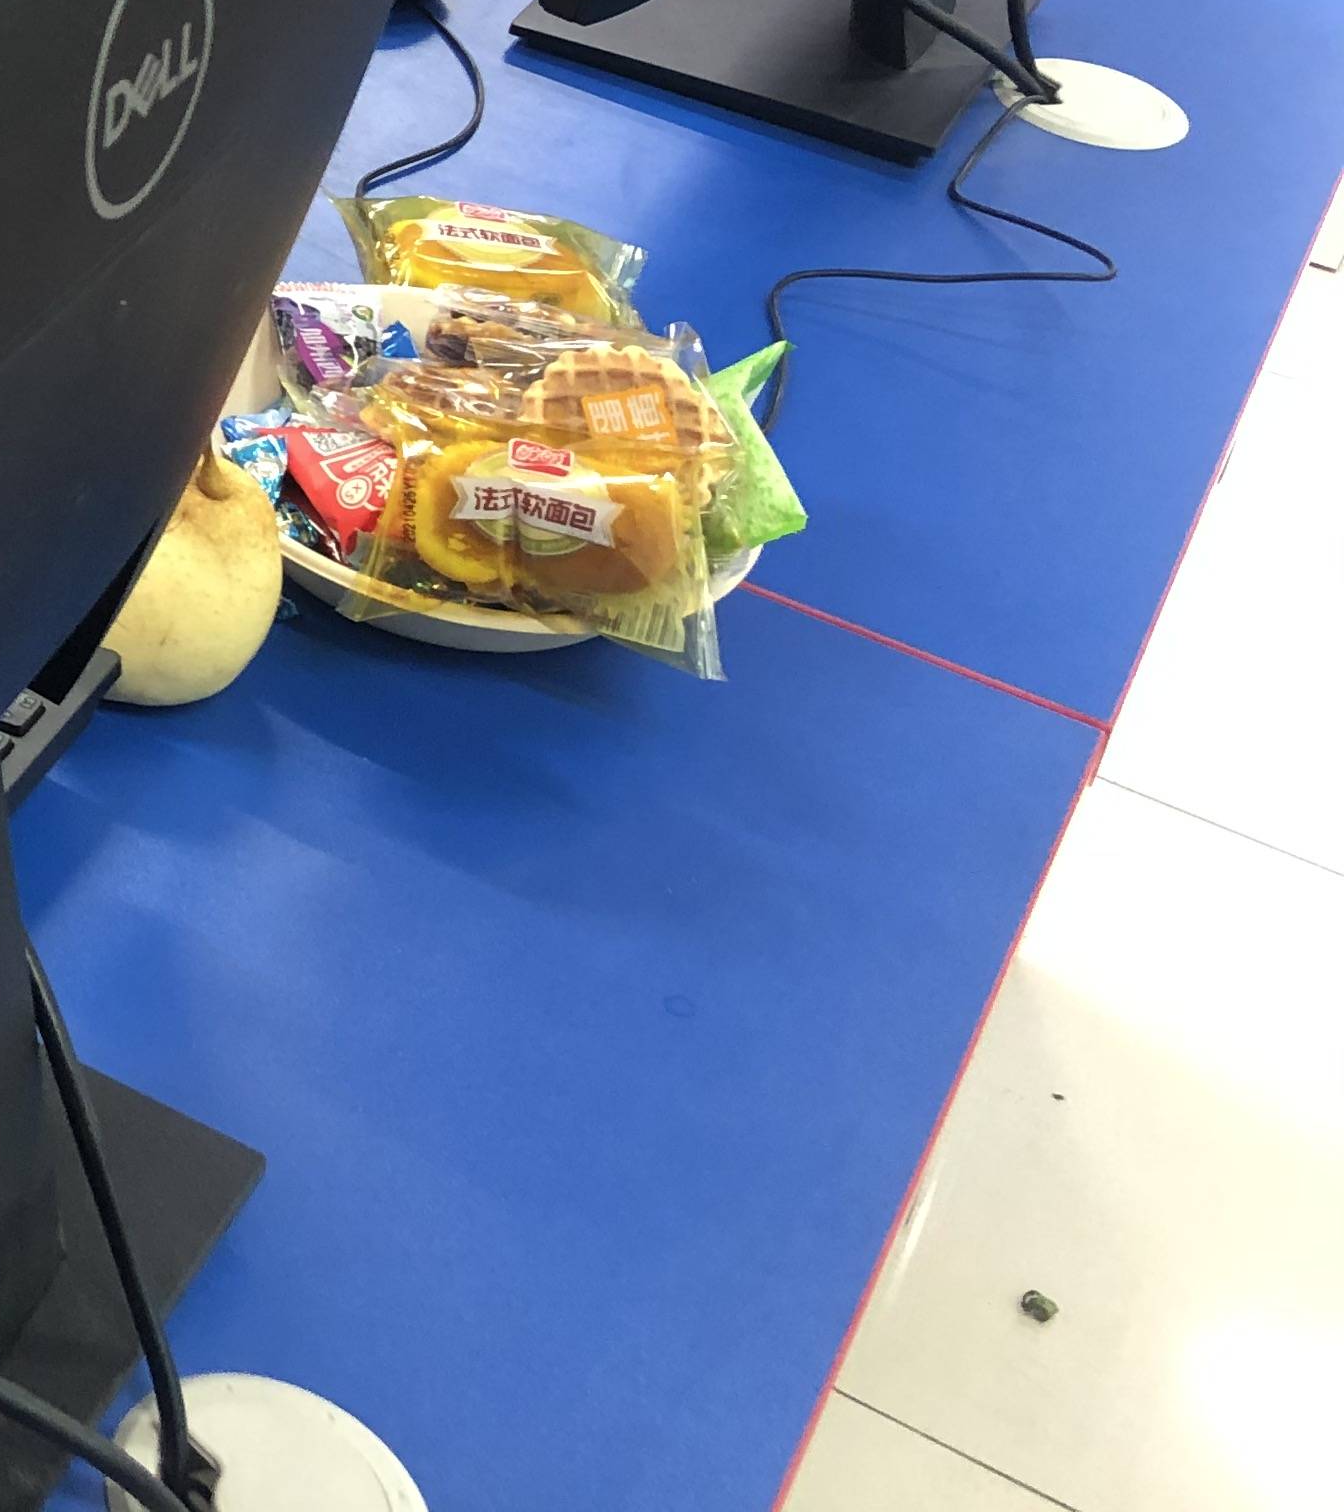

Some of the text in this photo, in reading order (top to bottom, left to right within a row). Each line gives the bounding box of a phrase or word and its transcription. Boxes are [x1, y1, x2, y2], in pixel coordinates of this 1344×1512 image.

[102, 21, 199, 149] DELL
[473, 486, 597, 533] 法式软面包
